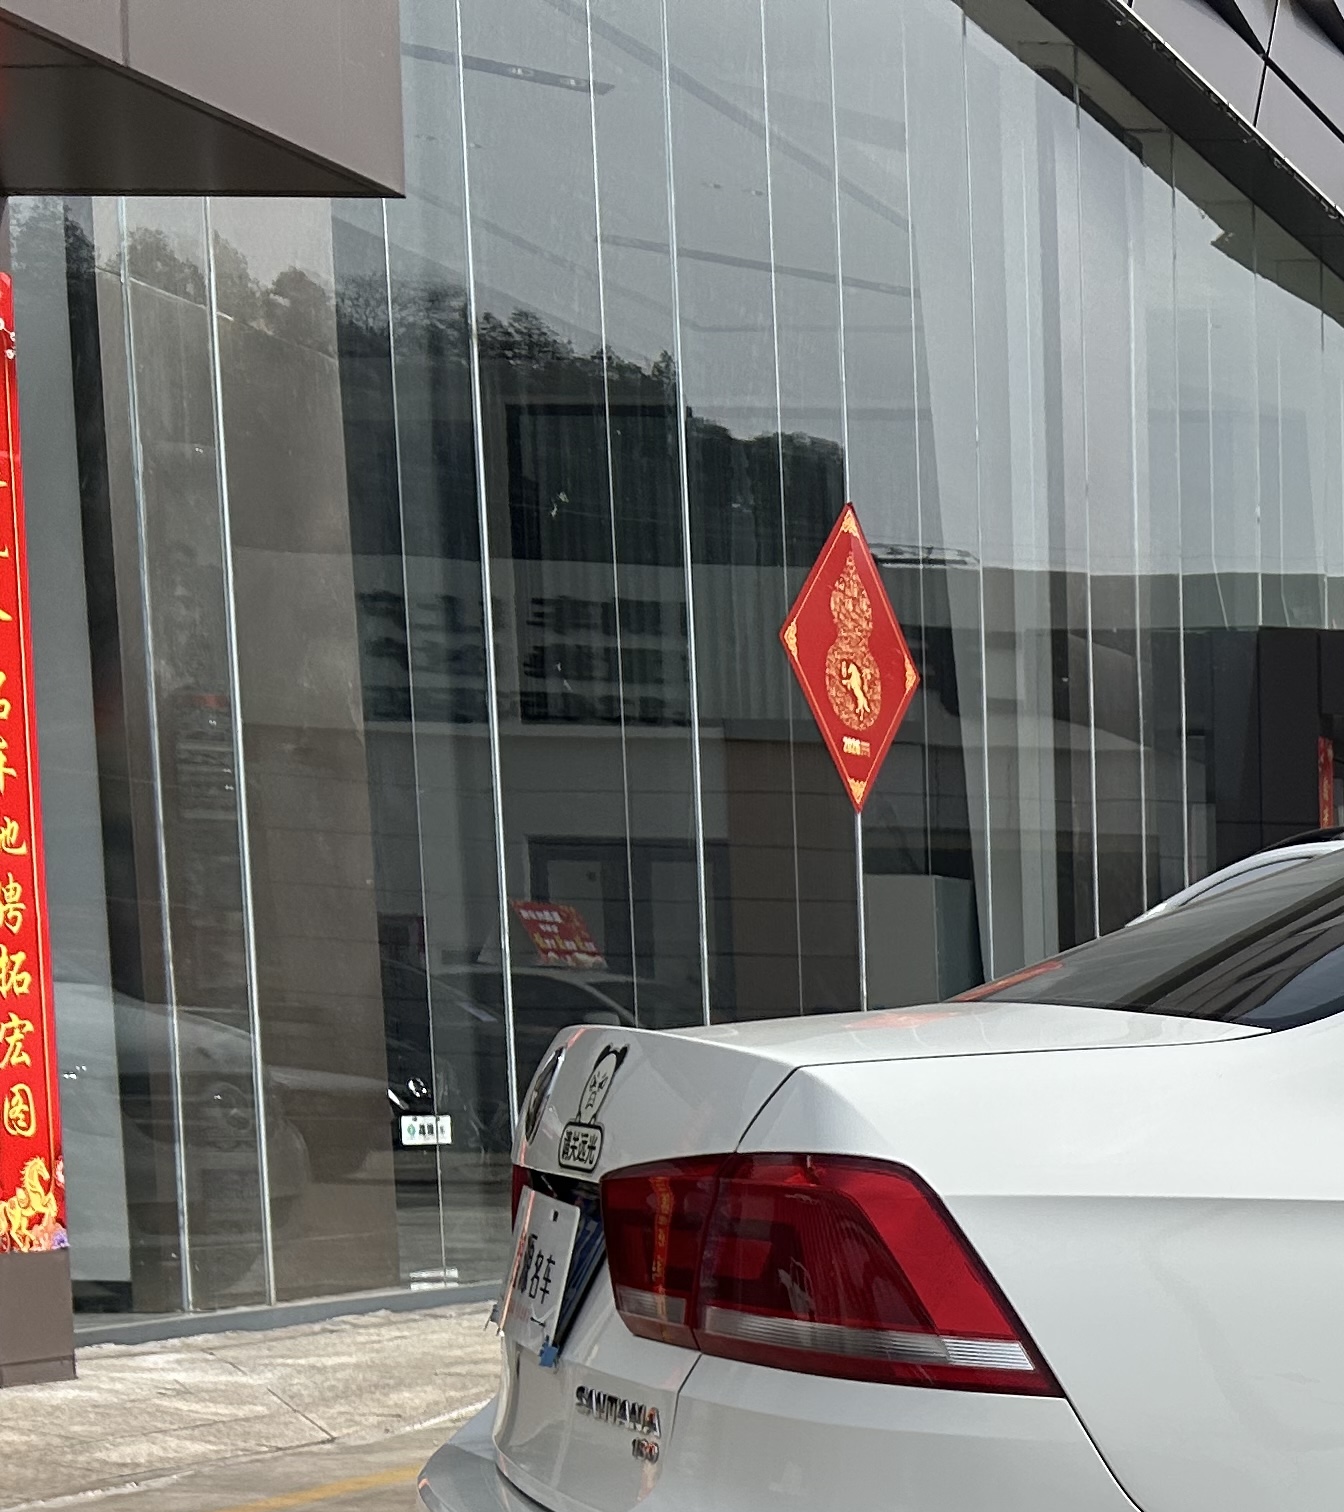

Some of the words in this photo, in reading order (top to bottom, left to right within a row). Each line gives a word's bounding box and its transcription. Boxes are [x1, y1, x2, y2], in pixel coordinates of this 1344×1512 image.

[562, 1129, 598, 1165] 请关远光
[575, 1385, 662, 1439] SANTANA
